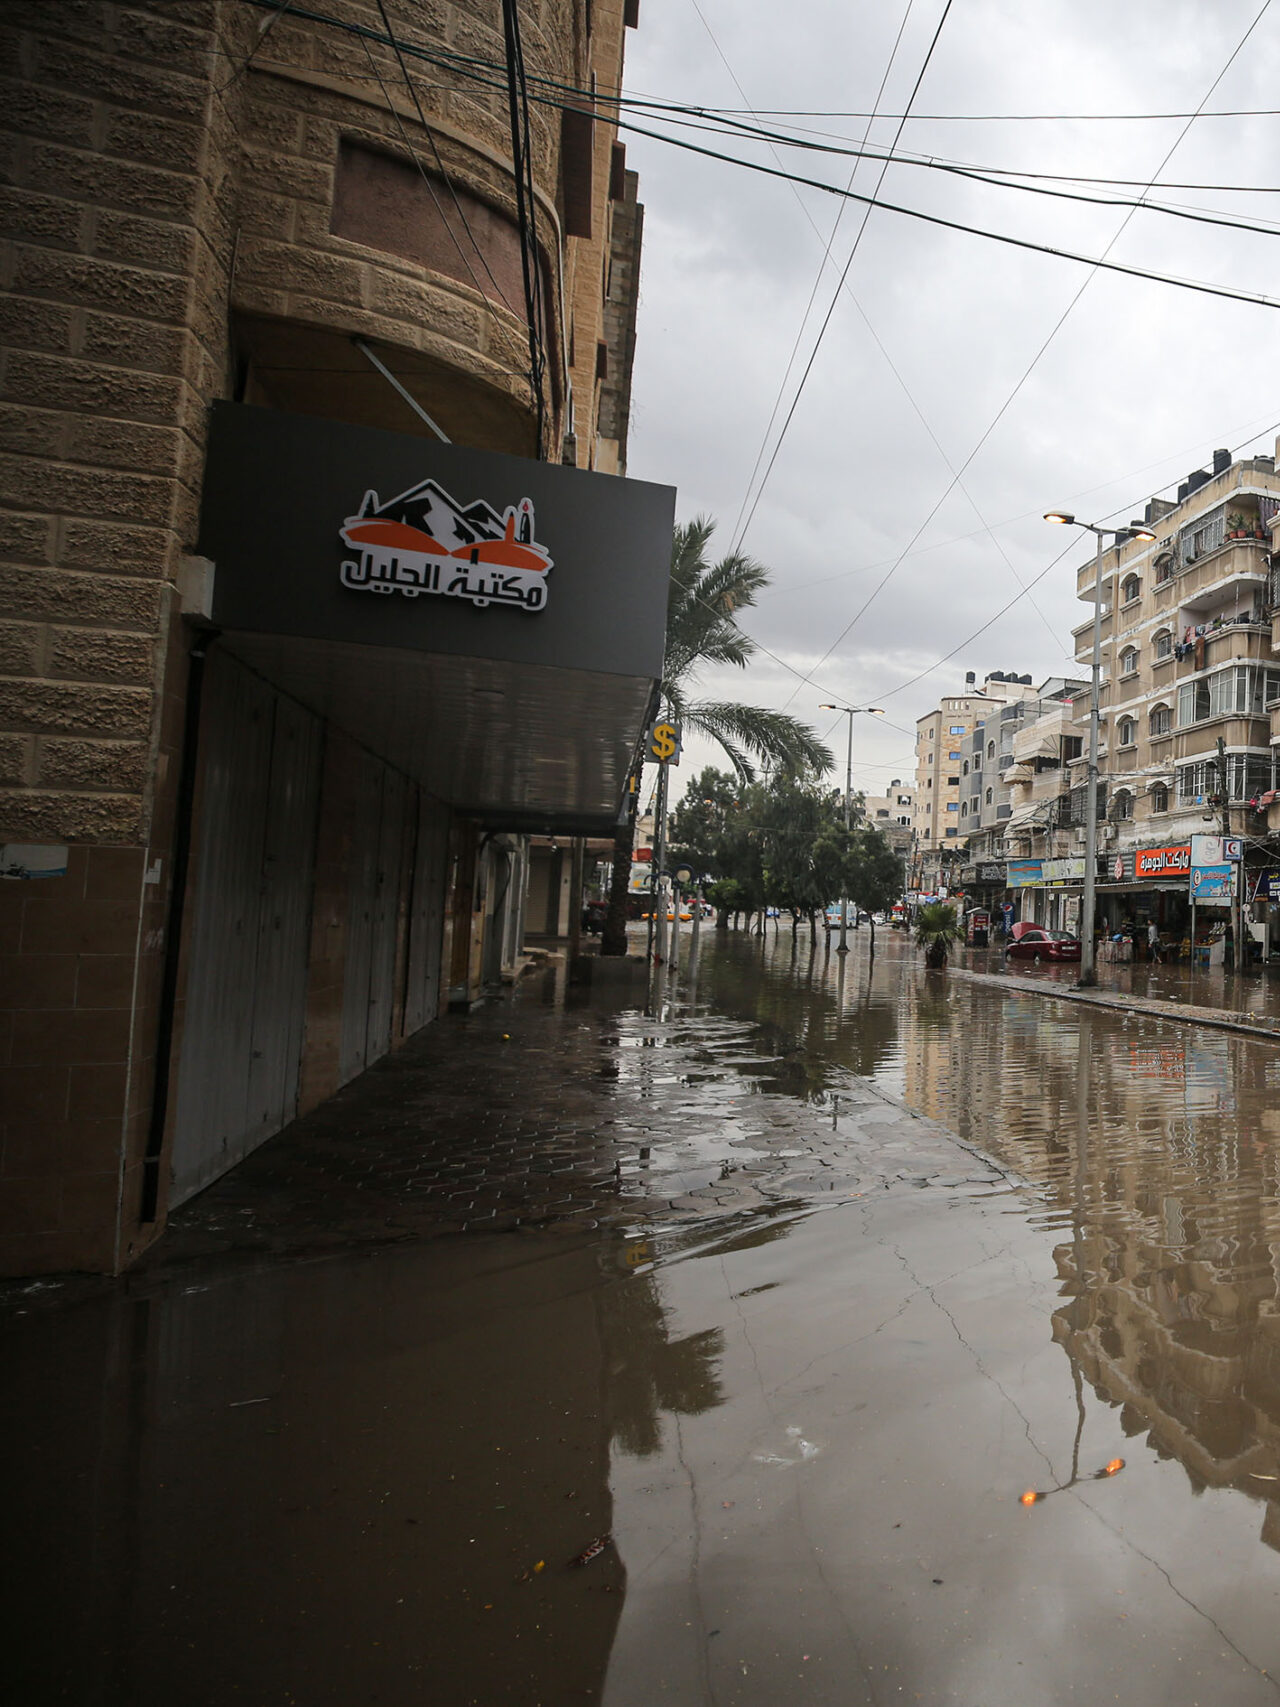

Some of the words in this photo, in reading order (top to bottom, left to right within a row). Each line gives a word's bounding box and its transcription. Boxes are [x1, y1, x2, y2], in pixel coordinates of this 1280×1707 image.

[346, 554, 440, 594] الجليل
[448, 566, 542, 607] مكتبة
[652, 723, 676, 760] $
[1140, 852, 1165, 872] الجوهرة
[1165, 850, 1189, 870] ماركت
